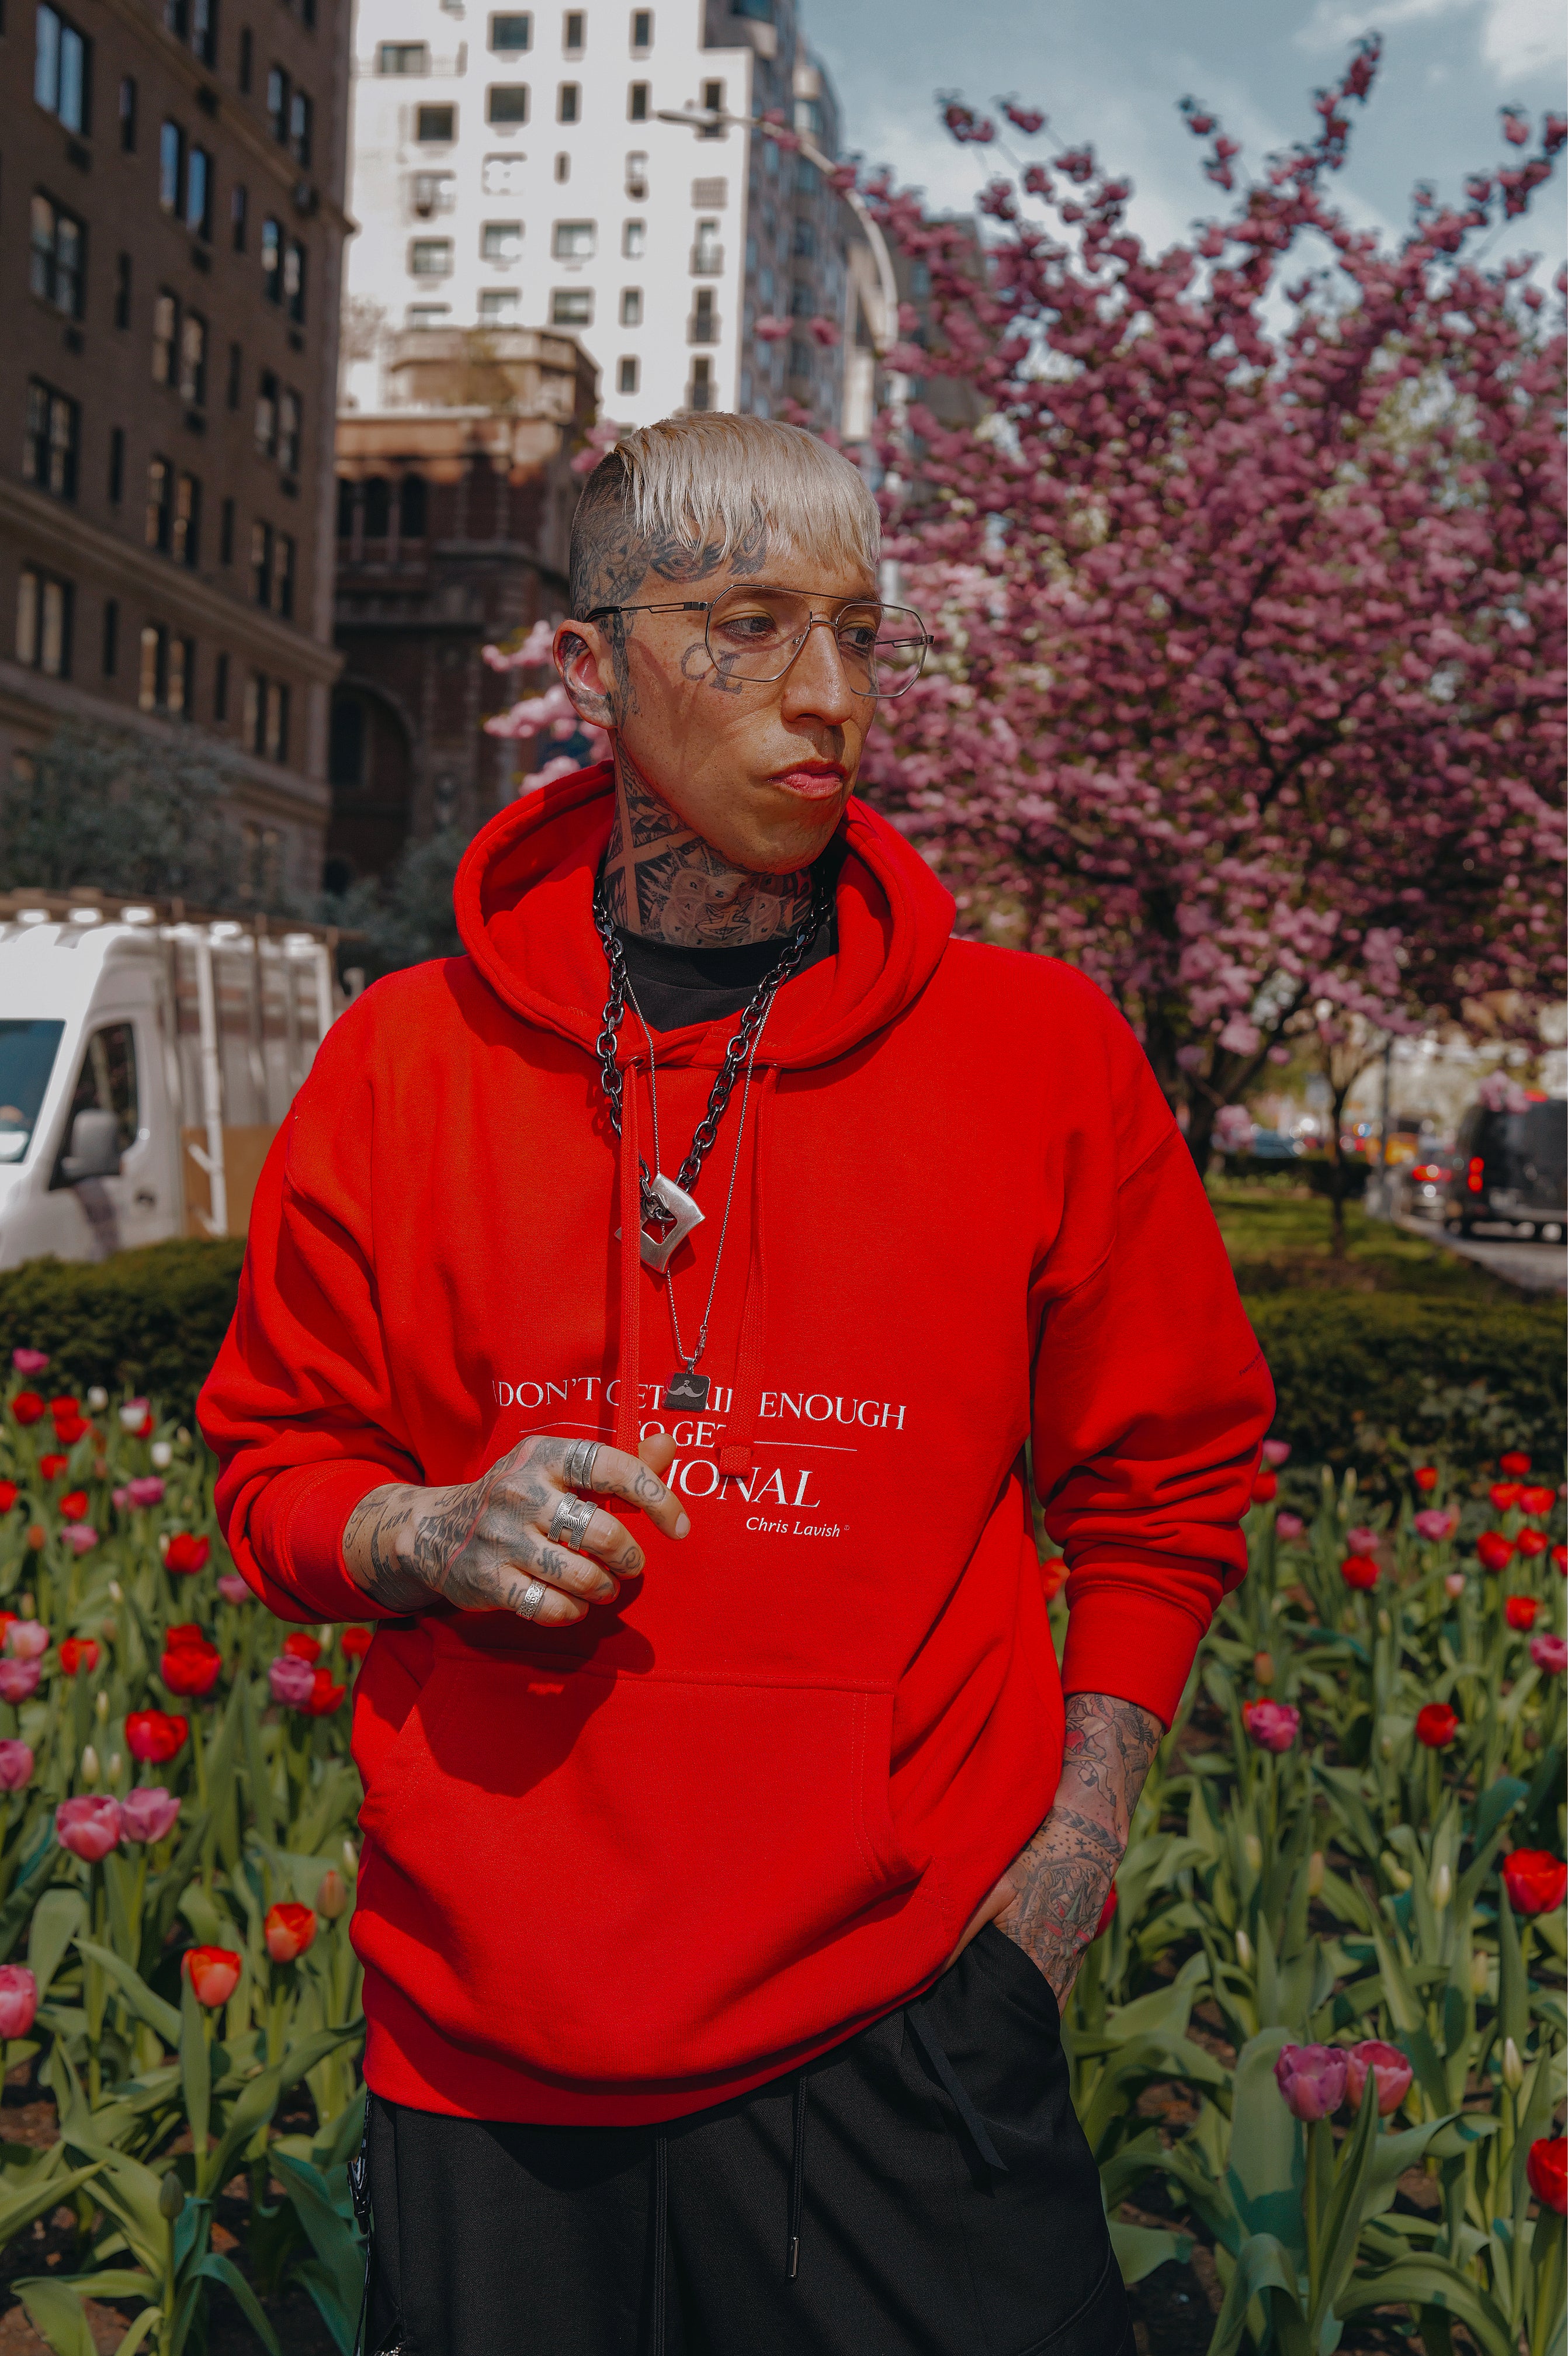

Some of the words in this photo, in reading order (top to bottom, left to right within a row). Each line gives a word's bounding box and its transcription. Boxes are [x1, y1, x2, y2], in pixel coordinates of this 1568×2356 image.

[498, 1377, 601, 1408] DON'T
[758, 1392, 907, 1430] ENOUGH
[746, 1517, 789, 1533] Chris
[793, 1521, 840, 1537] Lavish
